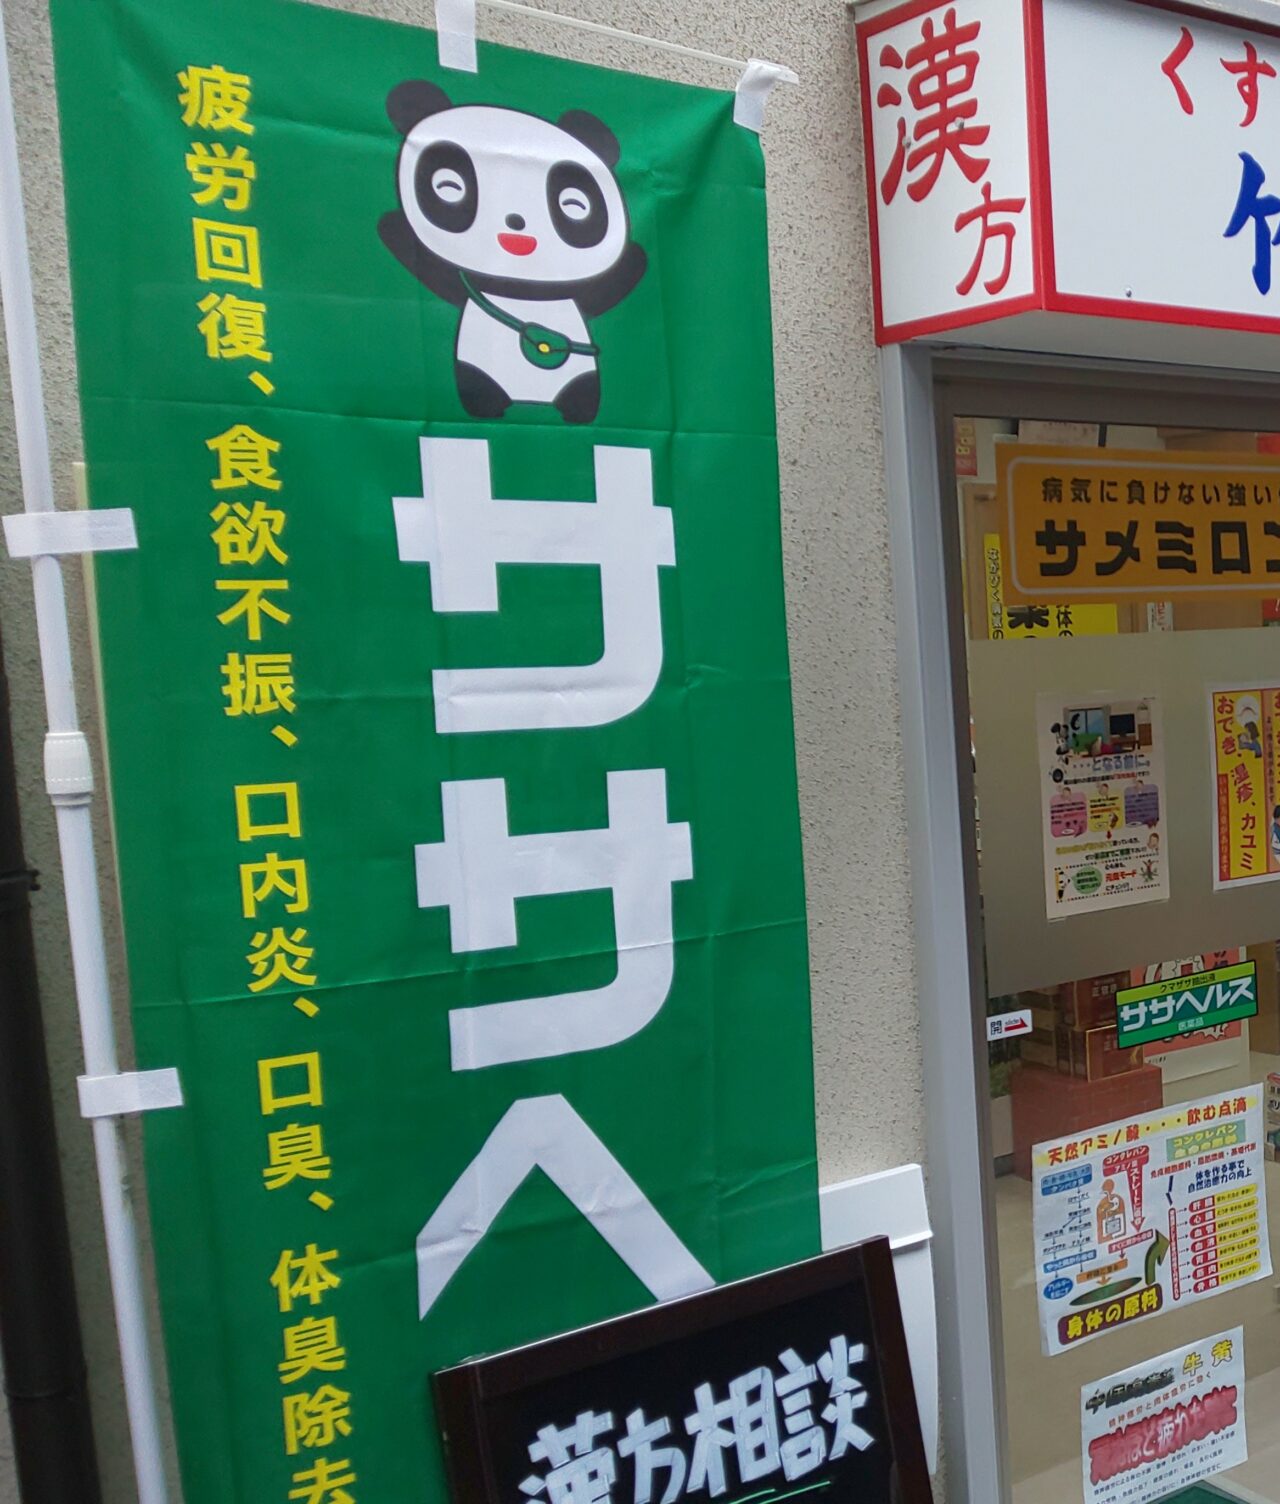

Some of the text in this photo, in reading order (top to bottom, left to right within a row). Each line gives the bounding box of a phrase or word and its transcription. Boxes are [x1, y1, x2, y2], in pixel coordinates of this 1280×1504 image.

[877, 6, 1026, 296] 漢方
[990, 1020, 1003, 1036] 開
[1120, 976, 1255, 1032] ササヘルス
[1066, 1287, 1158, 1339] 身体の原料
[1182, 1339, 1234, 1377] 牛黄
[516, 1333, 878, 1504] 漢方相談
